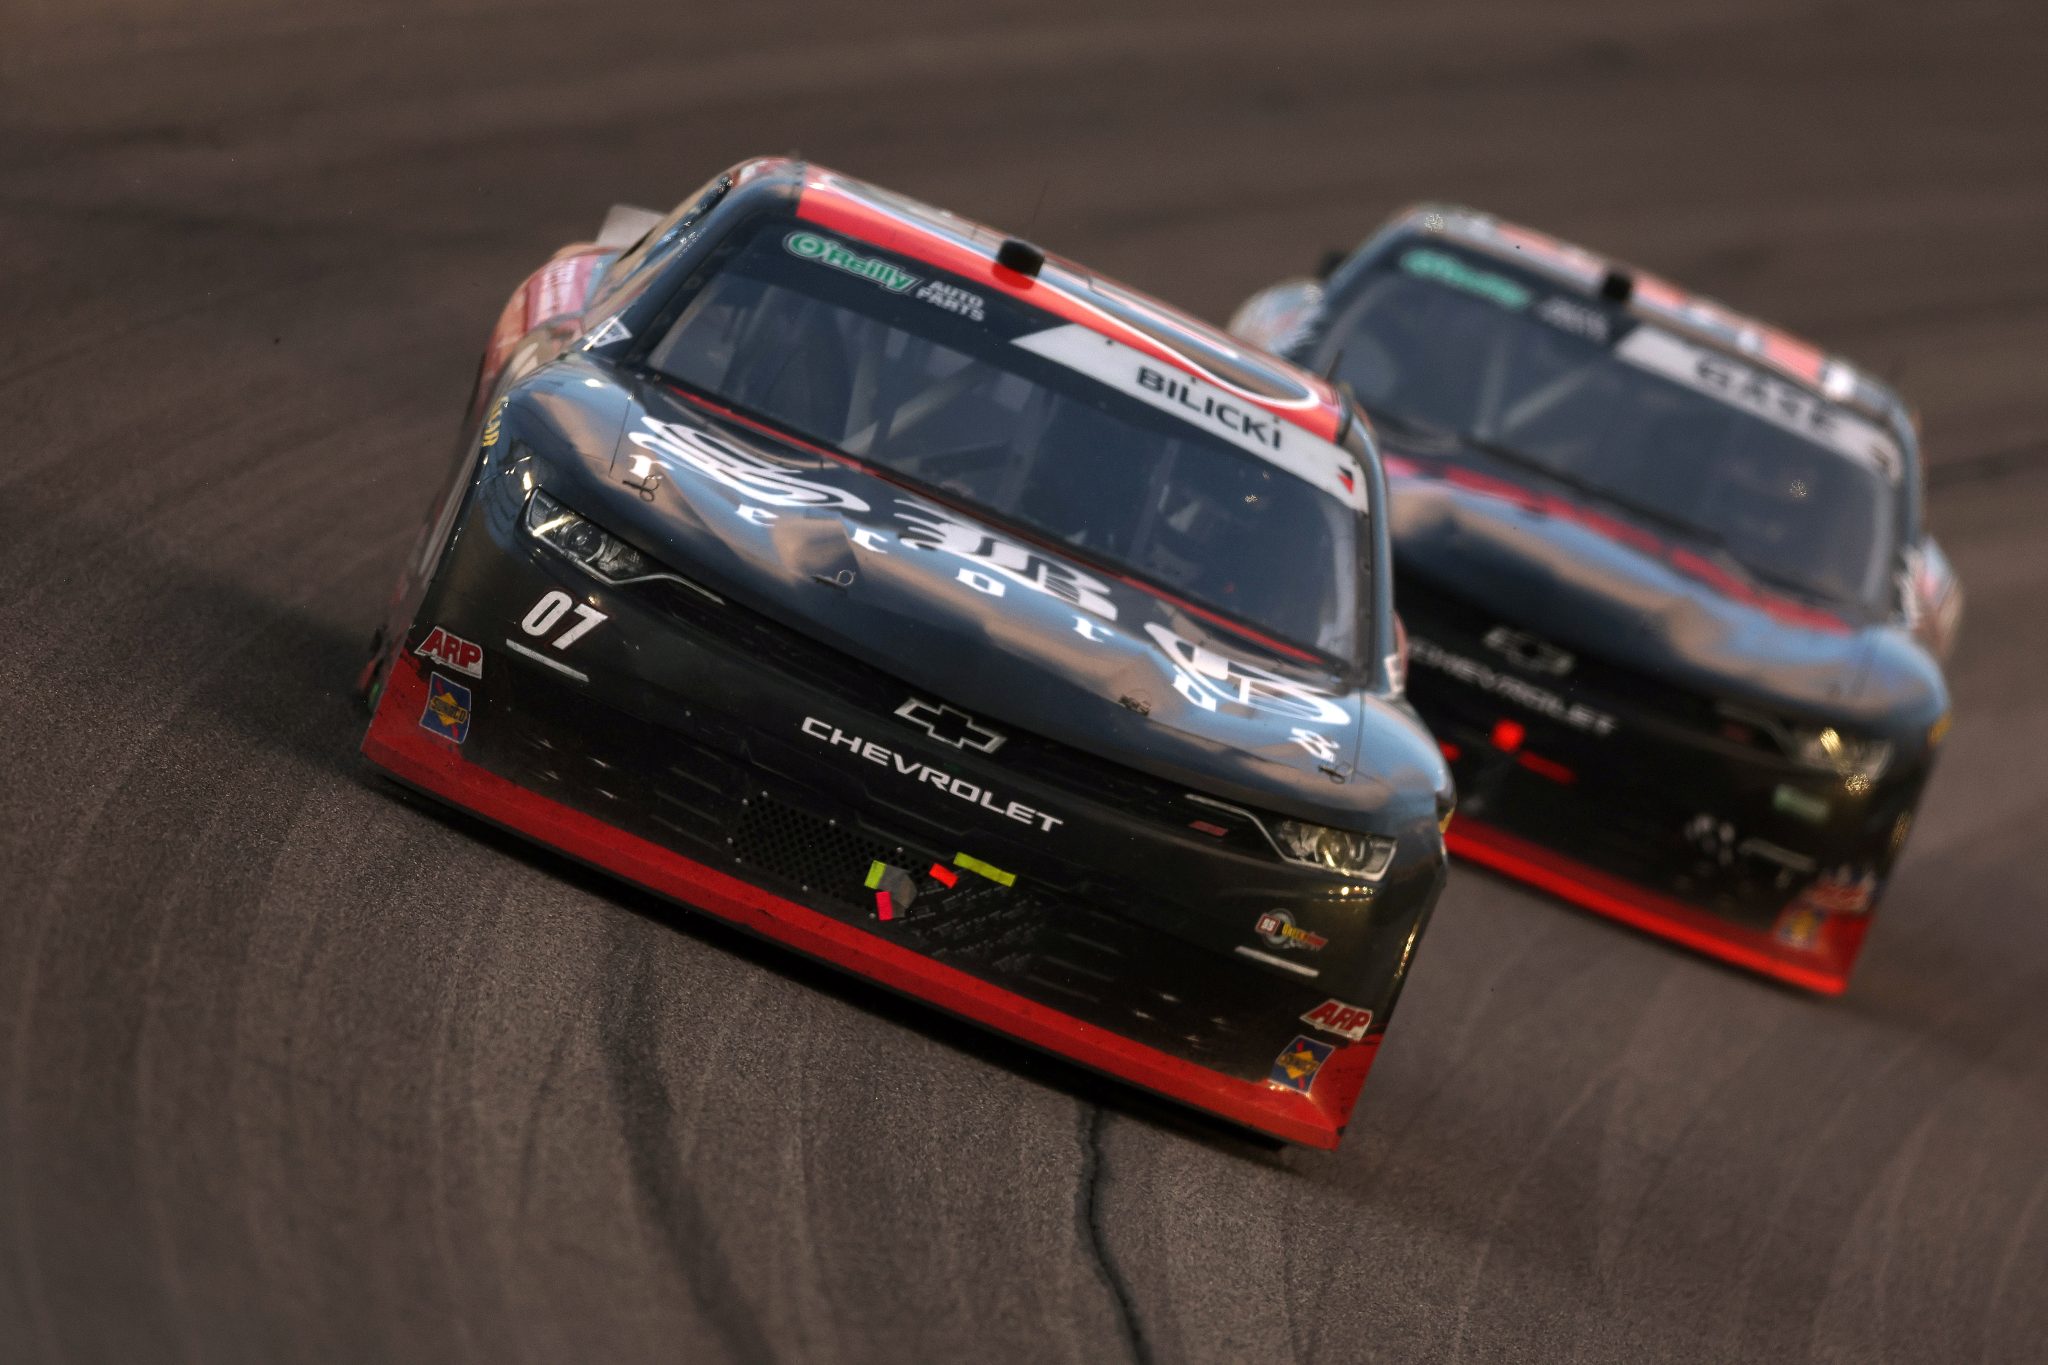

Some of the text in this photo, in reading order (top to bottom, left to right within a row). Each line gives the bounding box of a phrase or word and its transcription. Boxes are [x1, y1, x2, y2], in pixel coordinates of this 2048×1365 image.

[788, 232, 917, 292] O'Reilly
[915, 286, 985, 322] PARTS
[928, 281, 985, 309] AUTO
[521, 590, 608, 650] 07
[422, 629, 482, 668] ARP
[801, 716, 1064, 832] CHEVROLET
[1307, 1001, 1371, 1032] ARP
